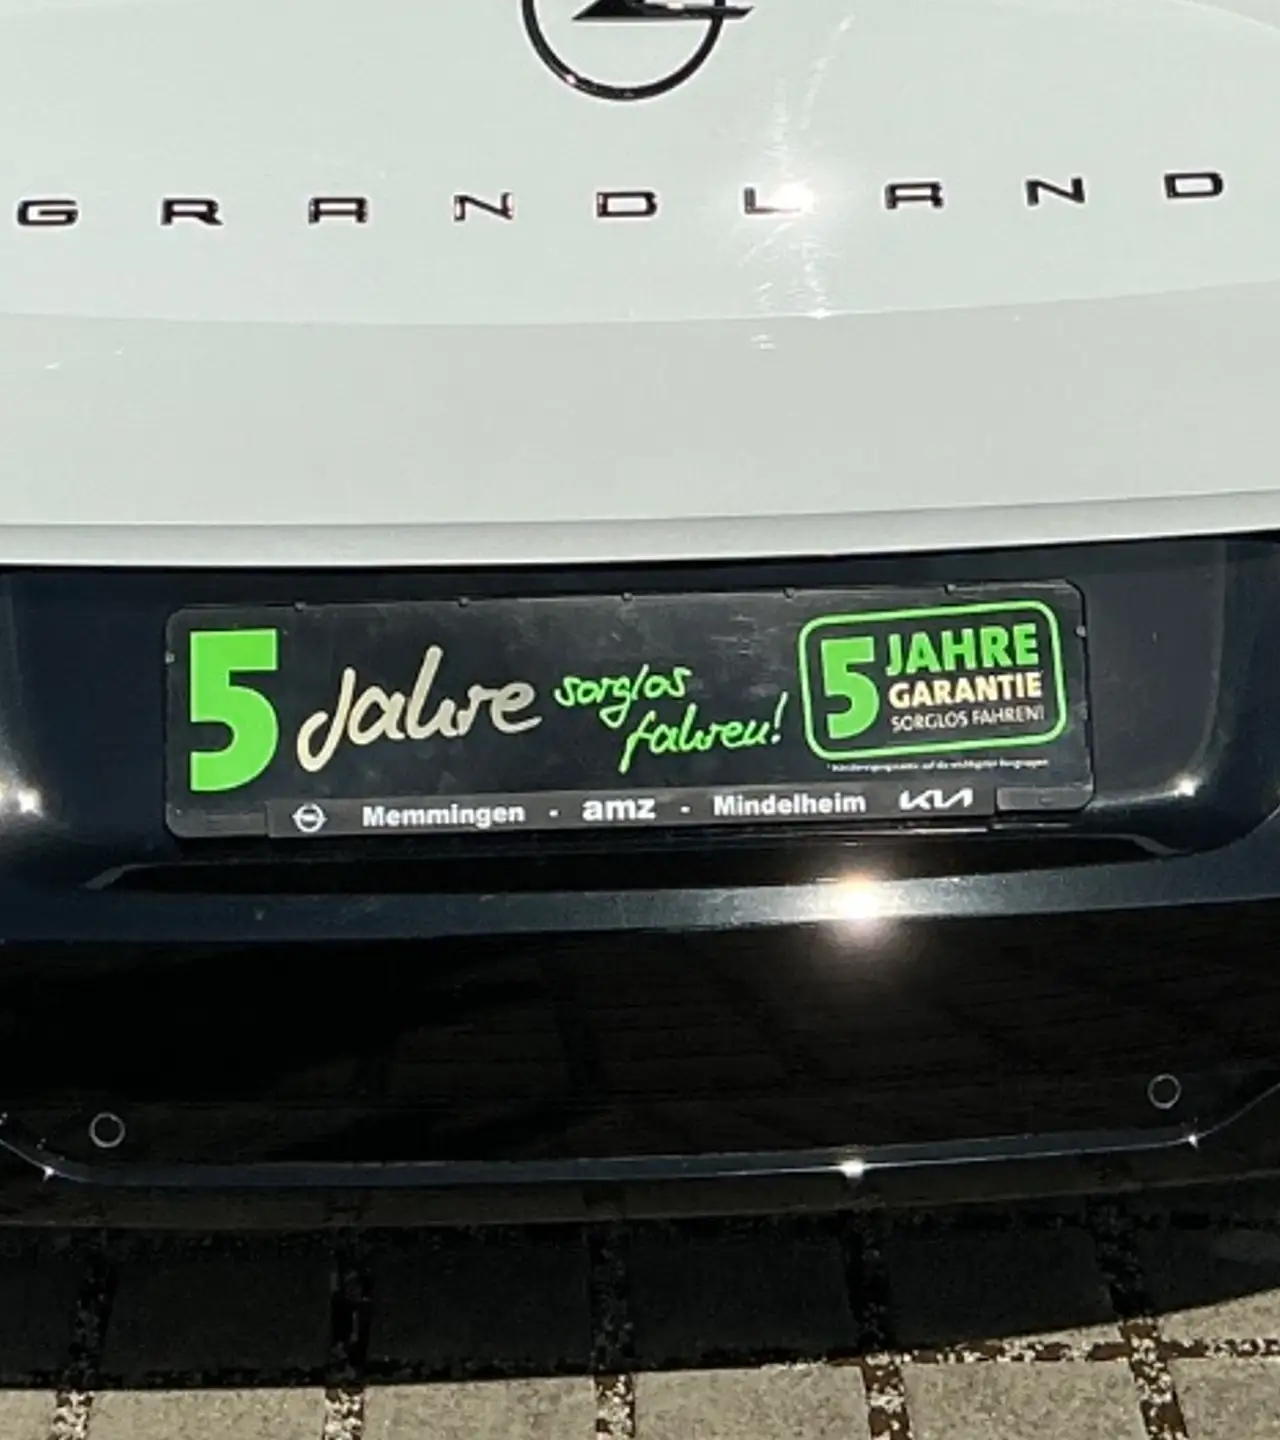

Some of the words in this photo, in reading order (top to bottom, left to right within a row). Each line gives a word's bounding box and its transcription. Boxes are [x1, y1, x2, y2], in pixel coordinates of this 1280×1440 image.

[17, 172, 1226, 229] GRANDLAND
[189, 628, 279, 792] 5
[296, 645, 543, 772] Jahre
[553, 664, 693, 728] sorglos
[820, 636, 880, 739] 5
[885, 622, 1039, 677] JAHRE
[888, 671, 1044, 709] GARANTIE
[618, 691, 789, 774] fahren!
[890, 711, 969, 733] SORGLOS
[971, 704, 1045, 727] FAHREN!
[362, 803, 526, 828] Memmingen
[582, 798, 657, 821] amz
[713, 792, 867, 816] Mindelheim
